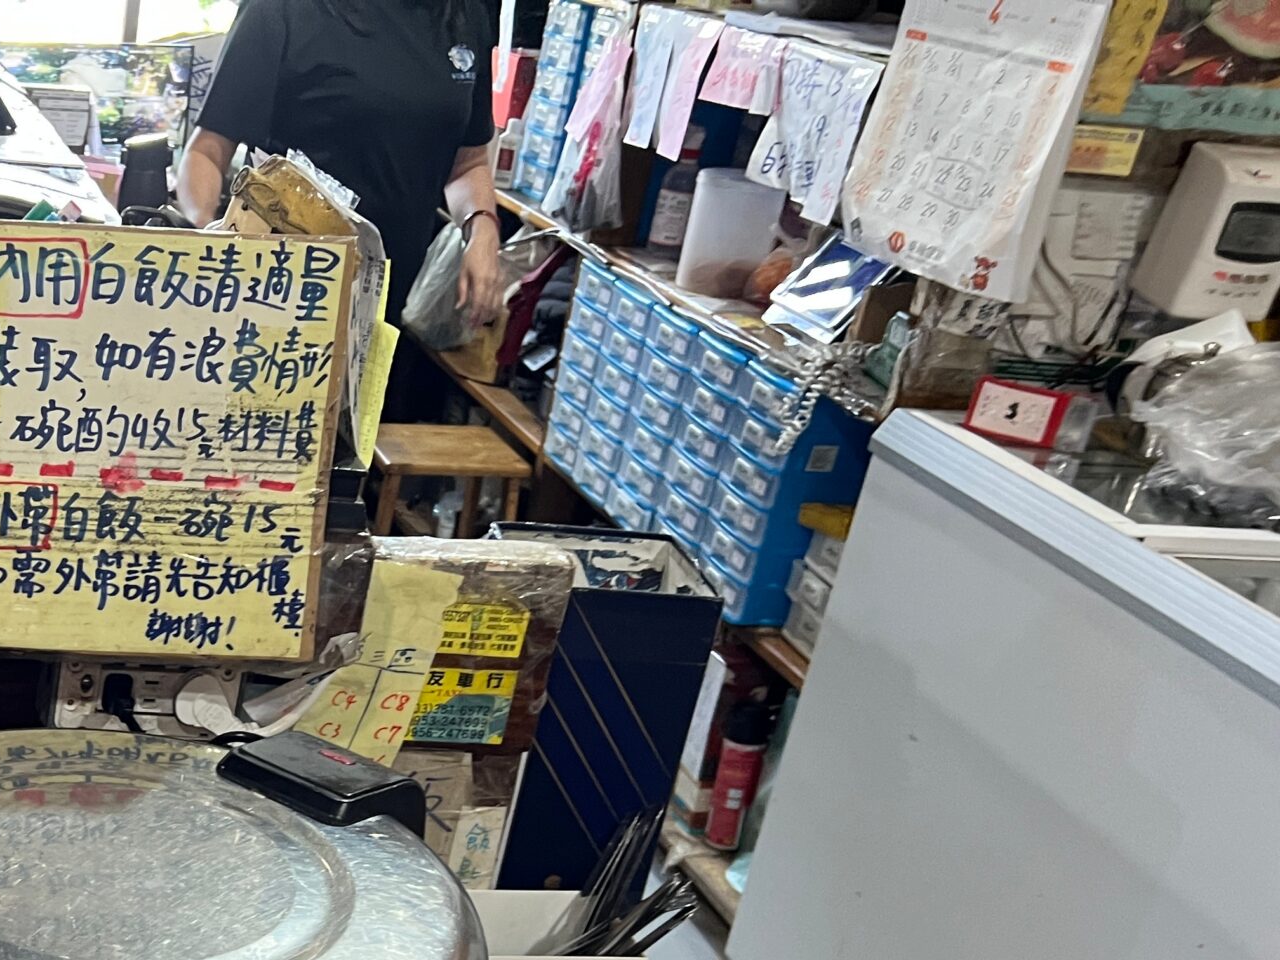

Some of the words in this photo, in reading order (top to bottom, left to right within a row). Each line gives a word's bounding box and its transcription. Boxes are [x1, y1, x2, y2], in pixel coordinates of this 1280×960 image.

[332, 690, 357, 710] C4
[380, 693, 410, 712] C8
[373, 725, 402, 744] C7
